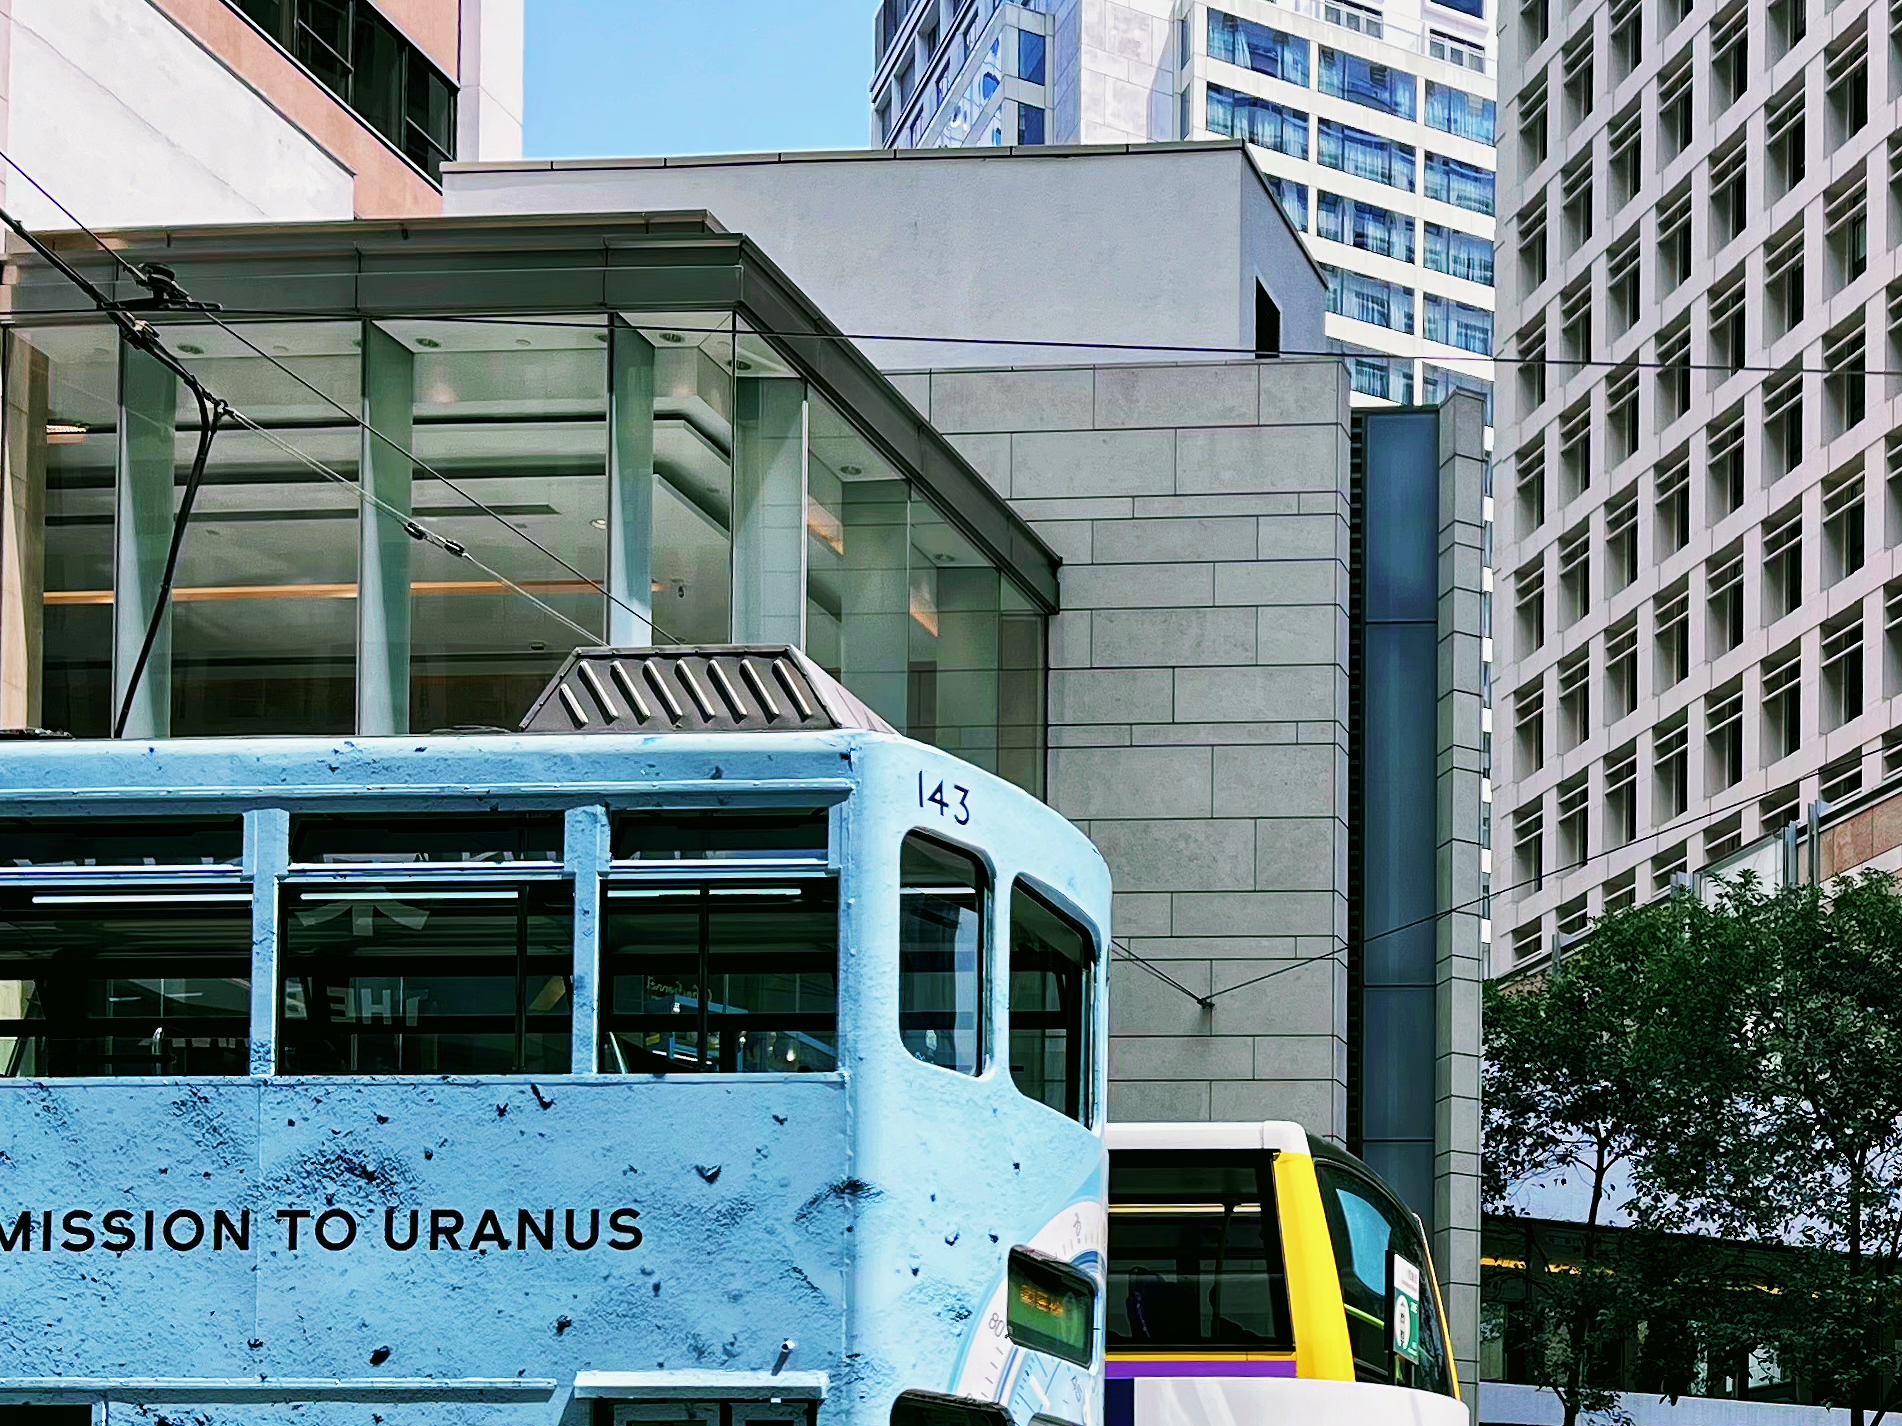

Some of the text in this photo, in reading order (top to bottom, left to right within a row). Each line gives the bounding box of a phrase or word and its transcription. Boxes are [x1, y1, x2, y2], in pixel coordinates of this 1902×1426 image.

[918, 769, 970, 826] 143
[0, 1208, 644, 1252] MISSION TO URANUS
[988, 1312, 1005, 1338] 80
